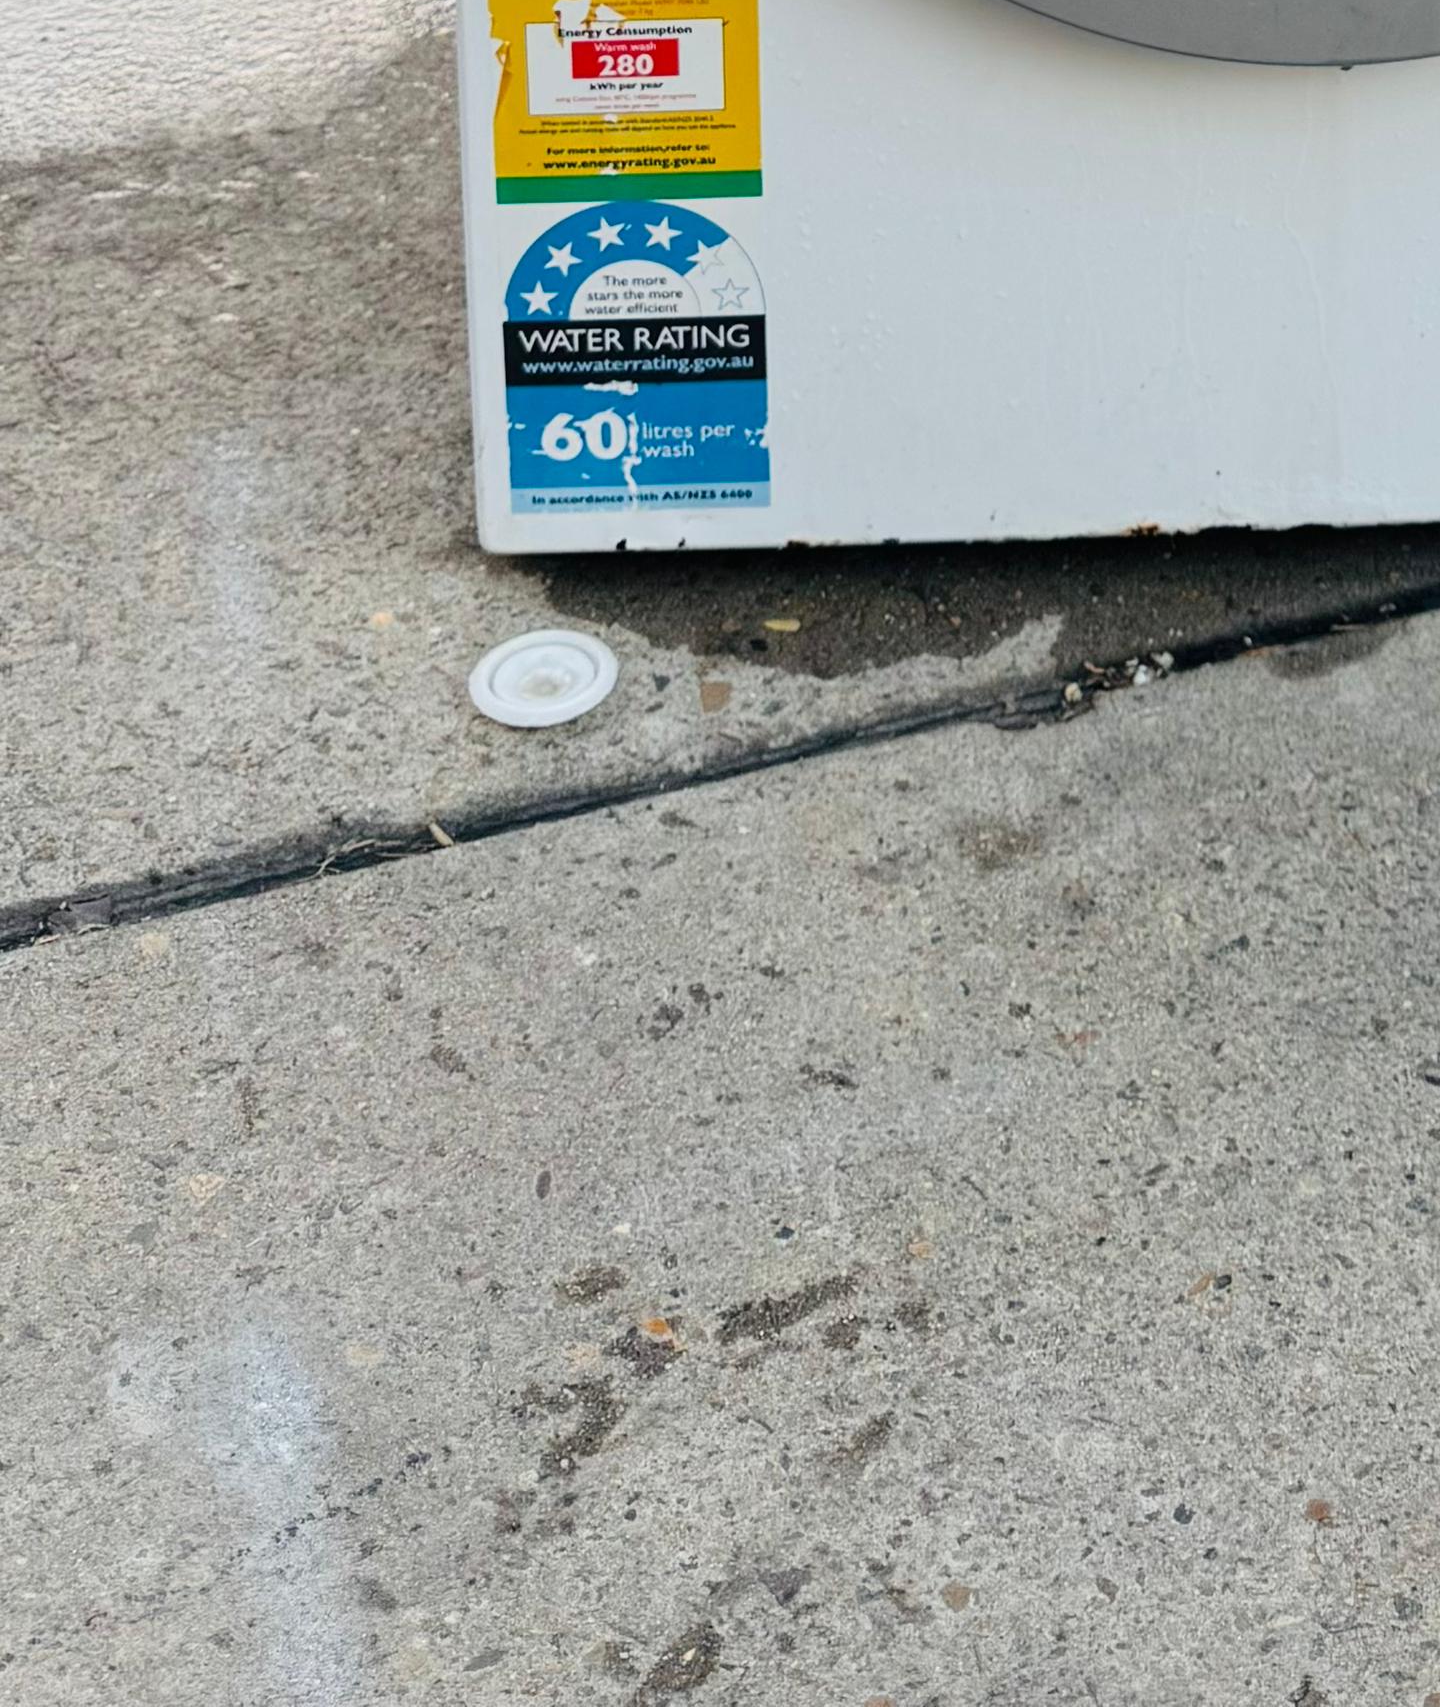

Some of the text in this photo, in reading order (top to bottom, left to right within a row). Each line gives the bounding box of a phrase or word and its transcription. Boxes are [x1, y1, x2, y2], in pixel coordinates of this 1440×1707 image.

[557, 25, 692, 39] Energy Consumption
[594, 41, 657, 53] Warm wash
[597, 54, 654, 77] 280
[543, 155, 717, 171] www.energyrating.gov.au
[603, 275, 667, 287] The more
[587, 289, 684, 302] stars the more
[585, 301, 679, 315] water efficient
[518, 324, 750, 353] WATER RATING
[523, 355, 754, 375] www.waterrating.gov.au
[541, 411, 628, 462] 60
[641, 422, 735, 443] litres per
[642, 441, 695, 458] wash
[532, 494, 546, 505] In
[549, 493, 625, 505] accordance
